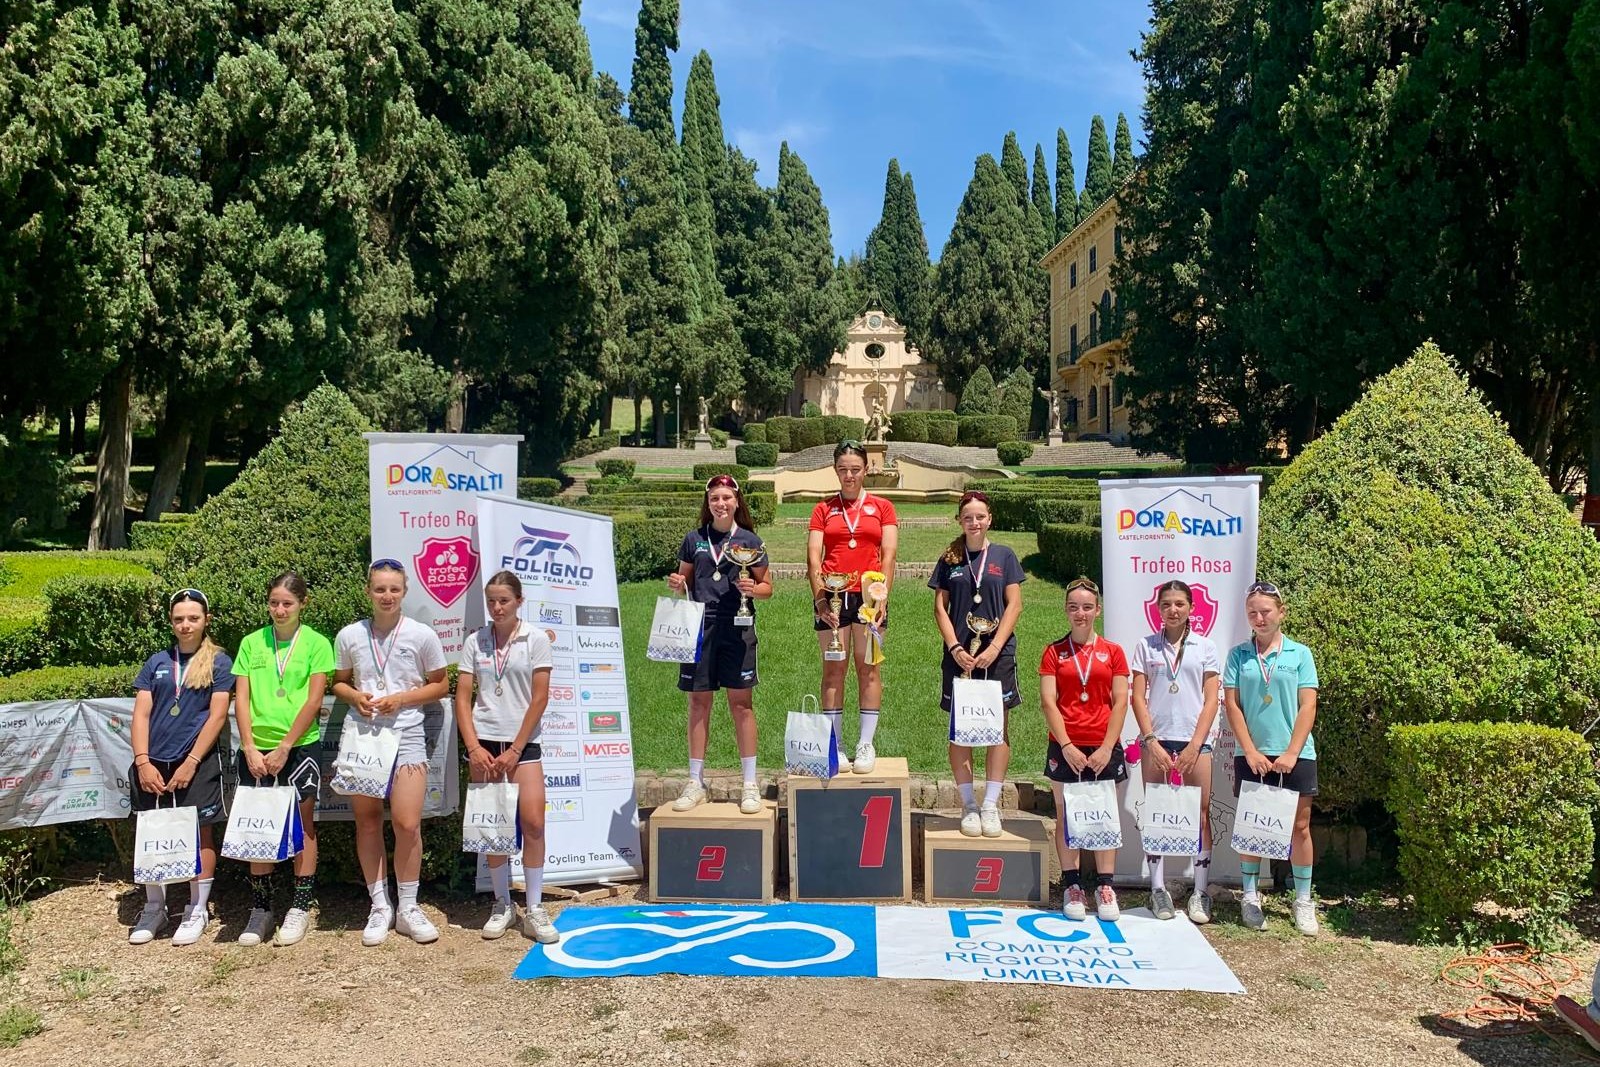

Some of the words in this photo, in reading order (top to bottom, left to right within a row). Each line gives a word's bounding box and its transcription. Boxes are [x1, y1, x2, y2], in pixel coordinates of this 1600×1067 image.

[386, 464, 503, 492] DORASFALTI
[400, 511, 450, 529] Trofeo
[457, 510, 478, 527] Ro
[1117, 509, 1243, 537] DORASFALTI
[1118, 533, 1175, 541] CASTELFIORENTINO
[427, 565, 467, 575] trofeo
[501, 555, 594, 580] FOLIGNO
[1130, 556, 1185, 574] Trofeo
[1192, 555, 1232, 573] Rosa
[427, 573, 467, 584] ROSA
[542, 575, 564, 584] TEAM
[658, 623, 690, 637] FRIA
[961, 705, 996, 718] FRIA
[555, 747, 578, 758] Roma
[584, 743, 630, 756] MATEG
[790, 739, 822, 753] FRIA
[346, 752, 383, 768] FRIA
[471, 813, 508, 824] FRIA
[1074, 810, 1112, 821] FRIA
[1152, 812, 1191, 826] FRIA
[1243, 811, 1283, 830] FRIA
[237, 817, 275, 830] FRIA
[859, 795, 893, 868] 1
[144, 838, 188, 852] FRIA
[548, 853, 586, 866] Cycling
[588, 852, 614, 861] Team
[696, 844, 727, 882] 2
[971, 857, 1004, 893] 3
[948, 909, 1127, 943] FCI
[954, 940, 1134, 957] COMITATO
[945, 951, 1155, 970] REGIONALE
[983, 967, 1131, 985] UMBRIA
